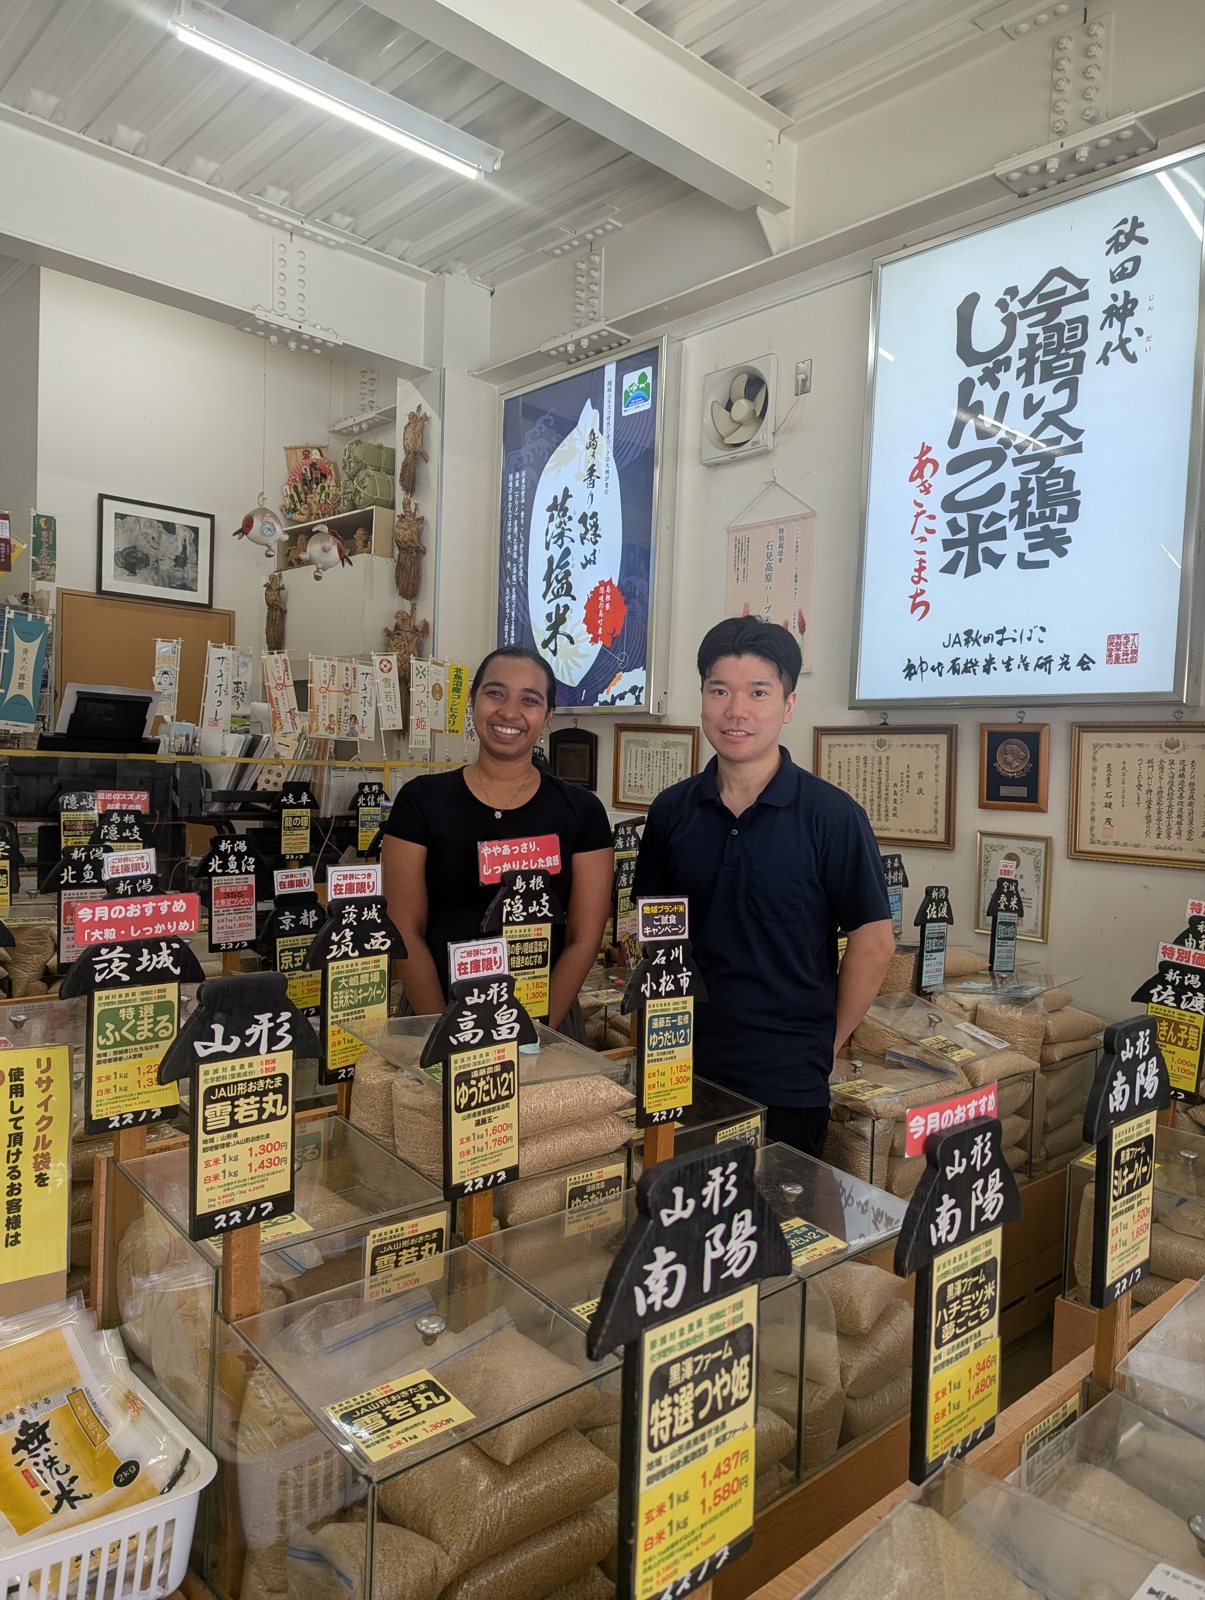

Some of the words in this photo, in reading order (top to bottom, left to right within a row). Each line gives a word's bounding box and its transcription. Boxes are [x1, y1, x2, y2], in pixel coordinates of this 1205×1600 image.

[1096, 216, 1149, 366] 秋田神代
[940, 285, 1020, 578] じゃんご米
[583, 428, 601, 510] 島の香り
[578, 511, 602, 570] 隠岐
[908, 442, 940, 621] あきたこまち
[541, 486, 577, 658] 藻塩米
[943, 626, 1047, 648] JA秋田おばこ
[214, 656, 226, 722] サキホコレ
[360, 672, 371, 728] サキホコレ
[383, 677, 396, 714] 雪若丸
[416, 683, 426, 730] つや姫
[63, 795, 96, 810] 隠岐
[281, 792, 311, 805] 岐阜
[358, 794, 385, 806] 北信州
[1103, 791, 1112, 809] 石破
[110, 812, 136, 824] 島根
[101, 825, 143, 841] 隠岐
[614, 835, 636, 849] 唐津
[71, 848, 104, 862] 新潟
[218, 839, 247, 853] 新潟
[481, 841, 540, 858] ややあっさり、
[60, 863, 105, 884] 北魚
[110, 861, 149, 875] 在庫限り
[208, 855, 256, 874] 北魚沼
[482, 855, 560, 876] しっかりとした食感
[116, 879, 154, 895] 新潟
[278, 878, 310, 890] 在庫限り
[333, 880, 376, 895] 在庫限り
[336, 873, 372, 881] ご好評につき
[513, 875, 545, 893] 島根
[78, 900, 187, 923] 今月のおすすめ
[502, 893, 554, 923] 隠岐
[643, 904, 685, 914] 地域ブランド米
[926, 901, 949, 919] 佐渡
[997, 894, 1019, 910] 登米
[278, 909, 318, 930] 京都
[341, 904, 382, 926] 茨城
[653, 914, 677, 925] ご試食
[84, 920, 196, 942] 「大粒・しっかりめ」
[643, 925, 685, 936] キャンペーン
[326, 929, 392, 960] 筑西
[460, 948, 498, 958] ご好評につき
[652, 945, 683, 965] 石川
[92, 941, 181, 983] 茨城
[280, 949, 306, 970] 京式
[457, 956, 504, 977] 在庫限り
[640, 966, 693, 998] 小松市
[1164, 968, 1202, 989] 新潟
[465, 982, 508, 1006] 山形
[1150, 984, 1205, 1015] 佐渡
[119, 1004, 155, 1020] 特選
[98, 1015, 173, 1046] ふくまる
[193, 1011, 293, 1057] 山形
[449, 1005, 520, 1045] 高畠
[1156, 1019, 1200, 1051] きん子舞
[649, 1028, 690, 1049] ゆうだい21
[1121, 1029, 1150, 1063] 山形
[96, 1071, 129, 1084] 玄米1kg
[136, 1064, 160, 1076] 1,22
[338, 1068, 355, 1080] スズ
[1170, 1064, 1196, 1077] 1,100円
[1171, 1056, 1197, 1069] 1,000円
[96, 1084, 129, 1097] 白米1kg
[136, 1078, 159, 1090] 1,35
[210, 1076, 283, 1100] JA山形おきたま
[456, 1070, 514, 1109] ゆうだい21
[670, 1076, 691, 1087] 1,300円
[1108, 1057, 1160, 1113] 南陽
[32, 1057, 54, 1188] リサイクル袋を
[205, 1091, 288, 1131] 雪若丸
[652, 1107, 684, 1122] スズノブ
[909, 1091, 996, 1140] 今月のおすすめ
[485, 1122, 513, 1138] 1,600円
[485, 1135, 513, 1150] 1,760円
[4, 1067, 25, 1249] 使用して頂けるお客様は
[203, 1153, 239, 1169] 玄米1kg
[248, 1141, 288, 1158] 1,300円
[945, 1131, 992, 1180] 山形
[203, 1169, 239, 1184] 白米1kg
[248, 1156, 288, 1174] 1,430円
[463, 1170, 507, 1194] スズノブ
[1113, 1154, 1153, 1197] ミルキークイーン
[571, 1186, 620, 1211] ゆうだい21
[659, 1161, 739, 1227] 山形
[214, 1201, 274, 1230] スズノブ
[930, 1167, 1004, 1247] 南陽
[379, 1231, 439, 1255] JA山形おきたま
[374, 1242, 440, 1275] 雪若丸
[634, 1208, 758, 1317] 南陽
[936, 1280, 996, 1328] ハチミツ米
[941, 1303, 990, 1344] 夢ごこち
[668, 1339, 733, 1389] 黒澤ファーム
[934, 1380, 961, 1404] 玄米1kg
[968, 1354, 997, 1381] 1,346円
[352, 1383, 429, 1418] JA山形おきたま
[352, 1391, 446, 1432] 雪若丸
[650, 1354, 751, 1448] 特選つや姫
[933, 1400, 961, 1425] 白米1kg
[967, 1374, 997, 1402] 1,480円
[422, 1417, 455, 1434] 1,300円
[117, 1464, 137, 1483] 2kg
[643, 1489, 690, 1526] 玄米1kg
[701, 1449, 749, 1490] 1,437円
[643, 1515, 689, 1552] 白米1kg
[700, 1474, 749, 1516] 1,580円
